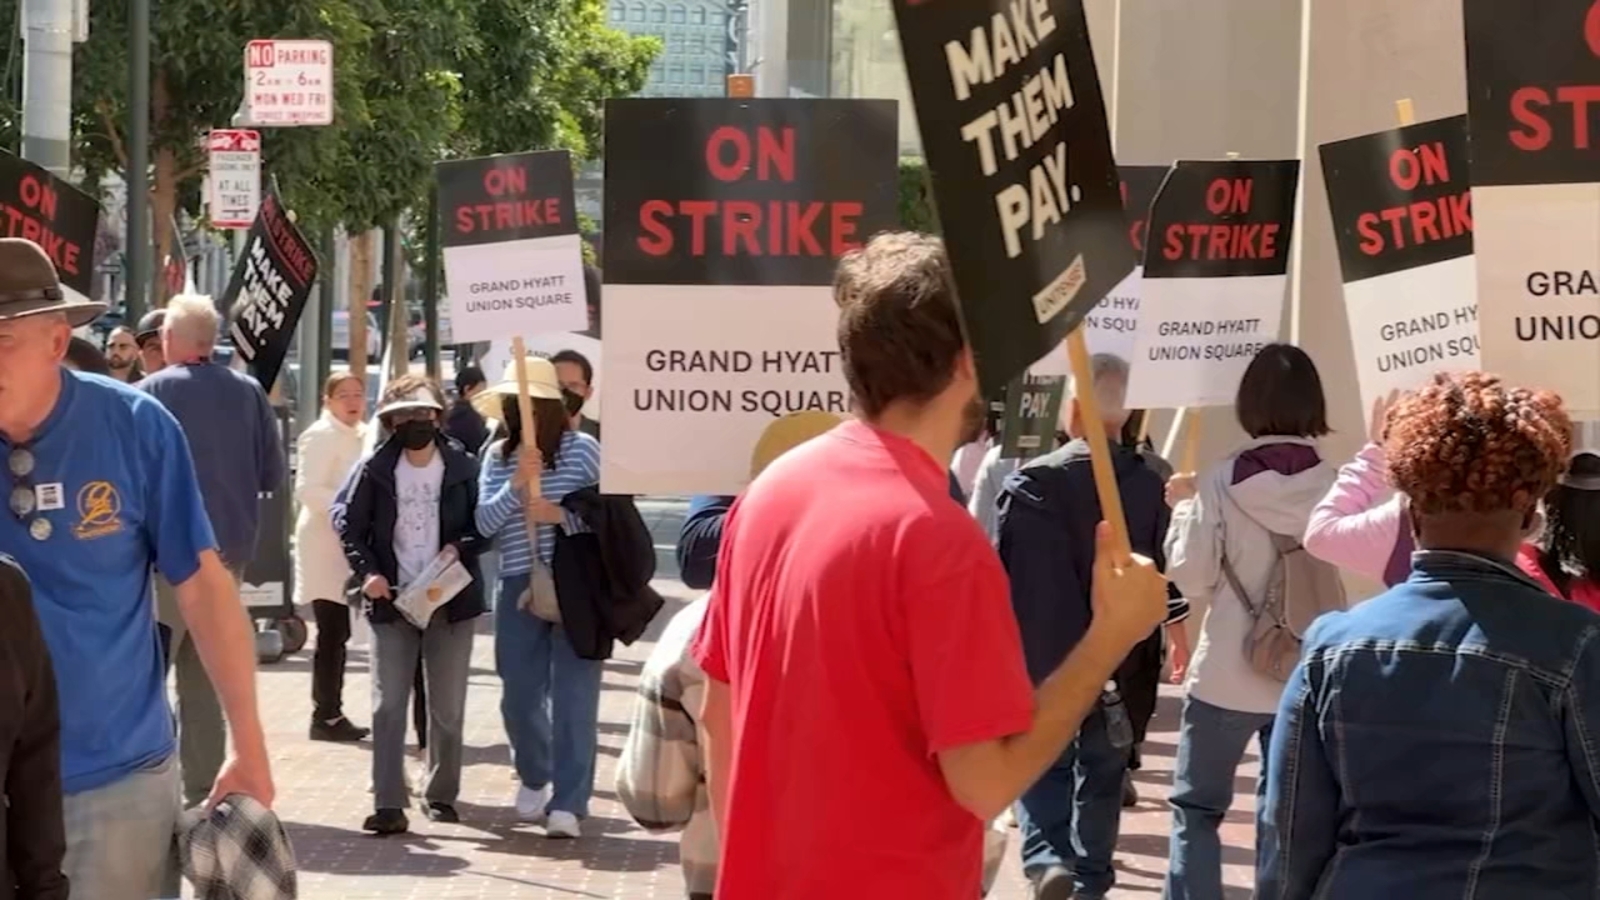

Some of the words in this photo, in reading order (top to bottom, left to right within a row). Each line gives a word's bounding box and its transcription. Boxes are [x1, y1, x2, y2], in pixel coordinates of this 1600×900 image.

[249, 44, 274, 67] NO
[278, 50, 326, 65] PARKING
[945, 0, 1057, 101] MAKE
[255, 93, 277, 105] MON
[282, 93, 304, 105] WED
[309, 93, 326, 105] FRI
[961, 53, 1075, 176] THEM
[705, 126, 796, 182] ON
[1388, 142, 1449, 190] ON
[219, 180, 230, 192] AT
[235, 180, 251, 192] ALL
[483, 167, 527, 196] ON
[1206, 178, 1253, 214] ON
[20, 174, 56, 222] ON
[995, 141, 1081, 258] PAY.
[457, 198, 561, 233] STRIKE
[637, 200, 864, 256] STRIKE
[0, 203, 80, 275] TRIKE
[1162, 224, 1280, 260] STRIKE
[251, 235, 294, 308] MAKE
[470, 279, 520, 295] GRAND
[522, 275, 566, 290] HYATT
[244, 257, 286, 330] THEM
[466, 299, 514, 313] UNION
[515, 292, 574, 310] SQUARE
[1159, 321, 1215, 337] GRAND
[1217, 319, 1261, 335] HYATT
[1380, 312, 1450, 341] GRAND
[645, 350, 752, 372] GRAND
[761, 351, 841, 373] HYAT
[1149, 345, 1200, 361] UNION
[1203, 343, 1264, 361] SQUARE
[1376, 344, 1443, 374] UNION
[633, 389, 732, 412] UNION
[740, 390, 852, 416] SQUAR
[1019, 392, 1051, 418] PAY.
